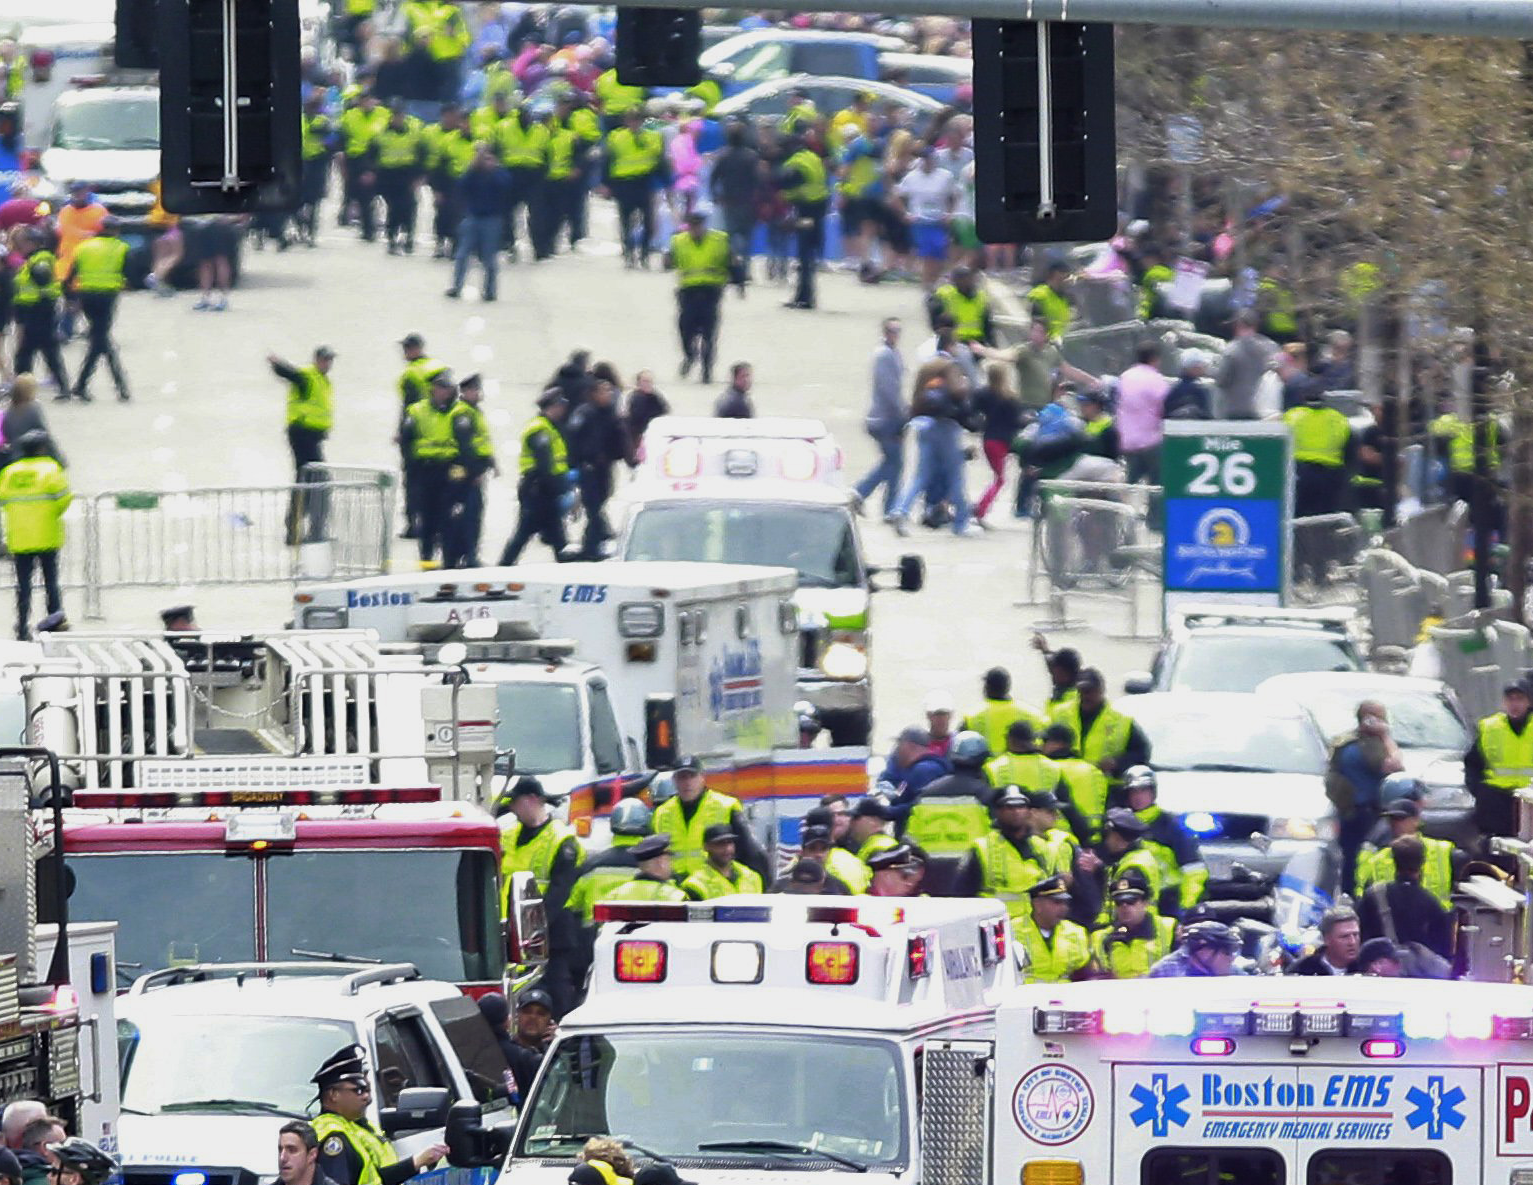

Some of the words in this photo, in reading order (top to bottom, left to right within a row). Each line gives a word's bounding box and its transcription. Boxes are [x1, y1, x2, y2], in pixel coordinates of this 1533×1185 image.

[1188, 453, 1257, 495] 26
[347, 590, 412, 608] Boston
[560, 584, 608, 603] EMS
[1202, 1073, 1315, 1106] Boston
[1323, 1074, 1394, 1107] EMS
[1202, 1121, 1276, 1138] EMERGENCY
[1278, 1121, 1333, 1139] MEDICAL
[1334, 1122, 1394, 1140] SERVICES
